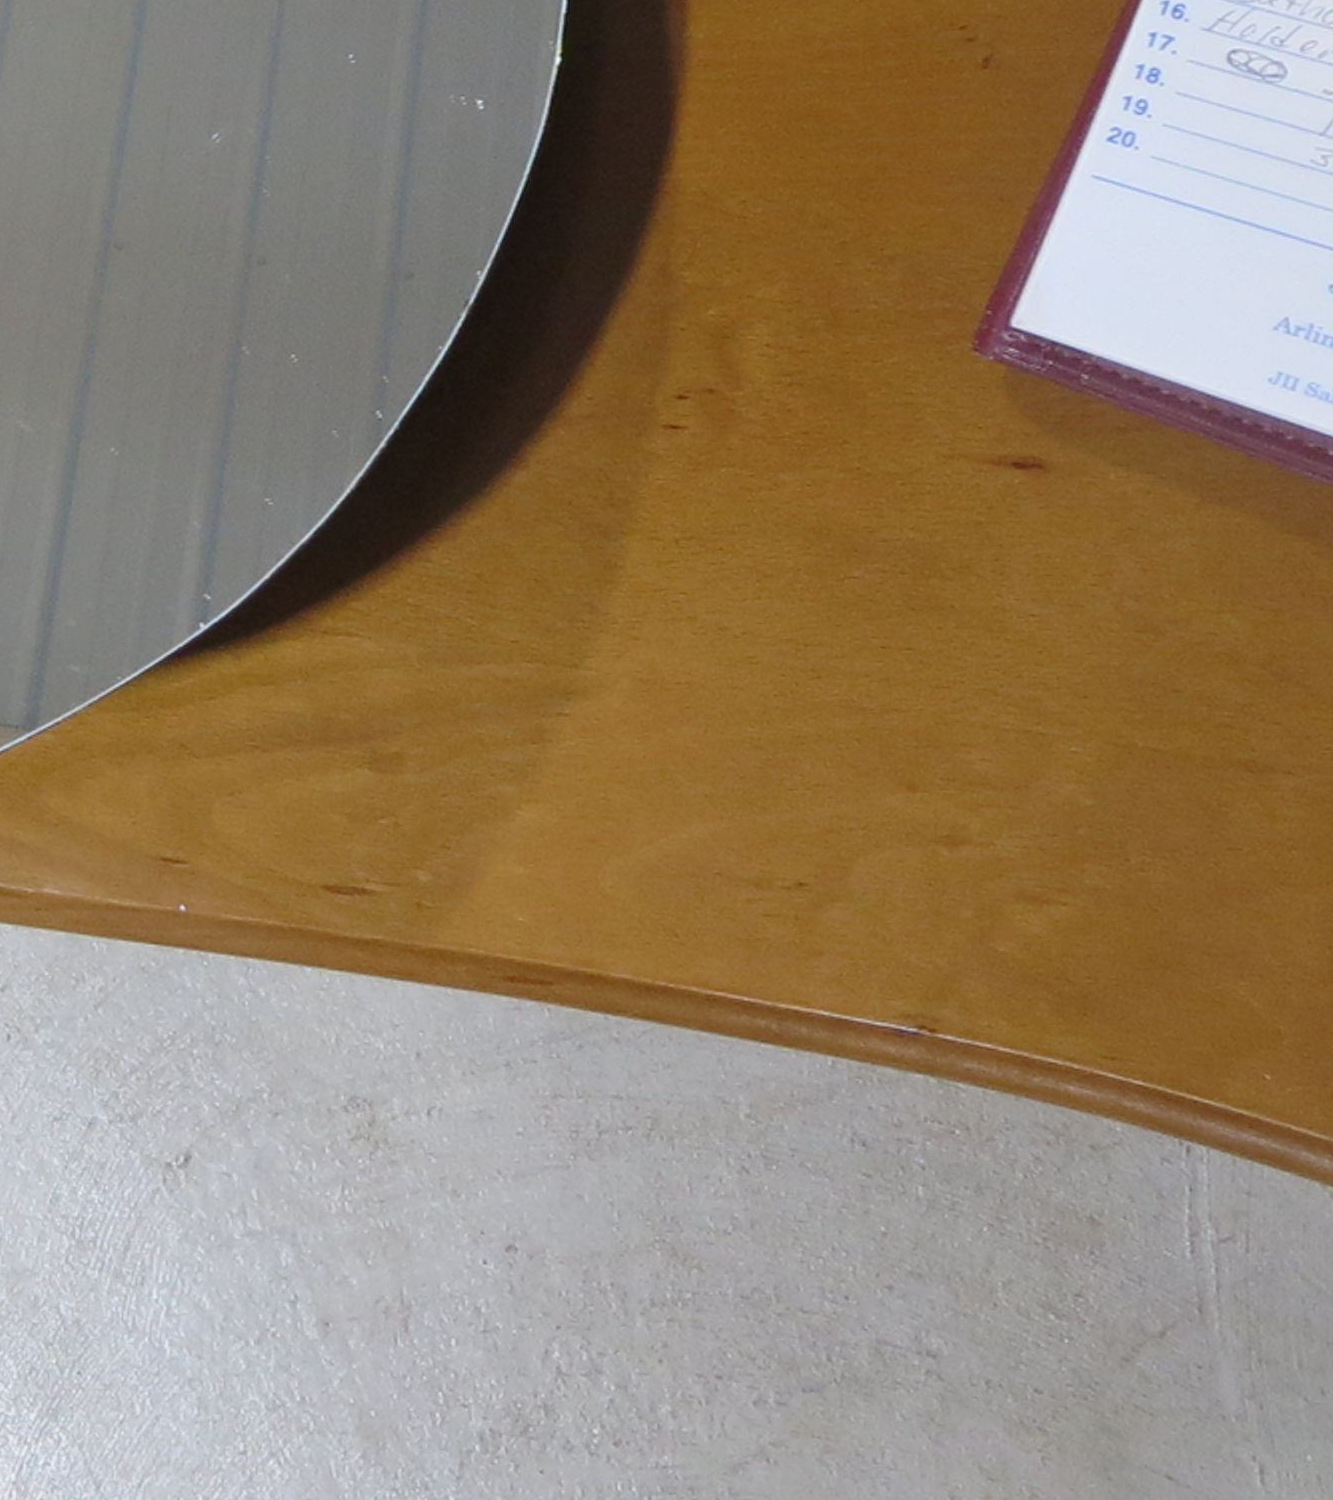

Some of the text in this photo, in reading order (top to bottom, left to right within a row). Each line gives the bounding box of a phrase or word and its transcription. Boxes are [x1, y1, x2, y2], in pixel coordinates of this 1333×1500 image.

[1159, 0, 1190, 23] 16.
[1146, 31, 1178, 55] 17.
[1134, 63, 1165, 87] 18.
[1121, 95, 1152, 119] 19.
[1105, 126, 1140, 151] 20.
